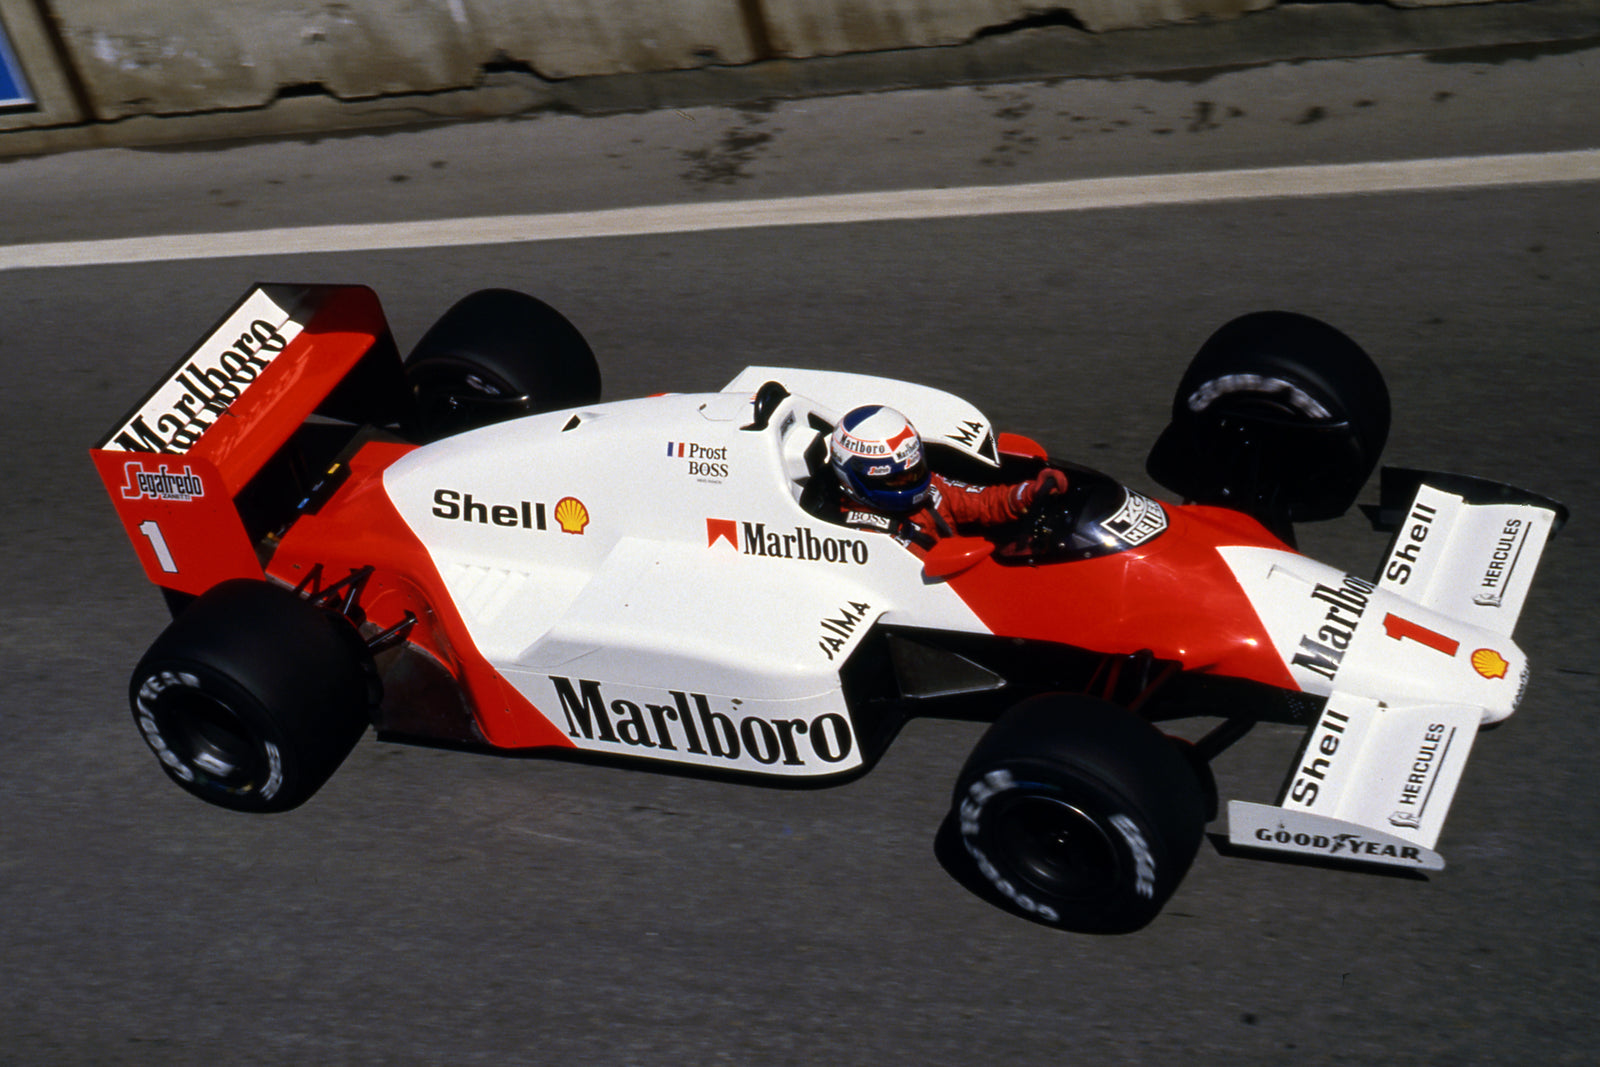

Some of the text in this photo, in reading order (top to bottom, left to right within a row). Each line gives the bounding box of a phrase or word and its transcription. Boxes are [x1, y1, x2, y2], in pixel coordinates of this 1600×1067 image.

[114, 319, 287, 454] Marlboro
[689, 443, 728, 460] Prost
[840, 434, 885, 454] Marlboro
[121, 462, 204, 499] Segafredo
[688, 461, 729, 478] BOSS
[432, 489, 547, 530] Shell
[850, 511, 889, 526] BOSS
[139, 520, 178, 574] 1
[742, 521, 869, 565] Marlboro
[1386, 503, 1437, 585] Shell
[1482, 518, 1522, 587] HERCULES
[819, 601, 871, 660] SAIMA
[1382, 612, 1460, 657] 1
[548, 675, 853, 765] Marlboro
[1292, 709, 1350, 807] Shell
[1398, 722, 1446, 805] HERCULES
